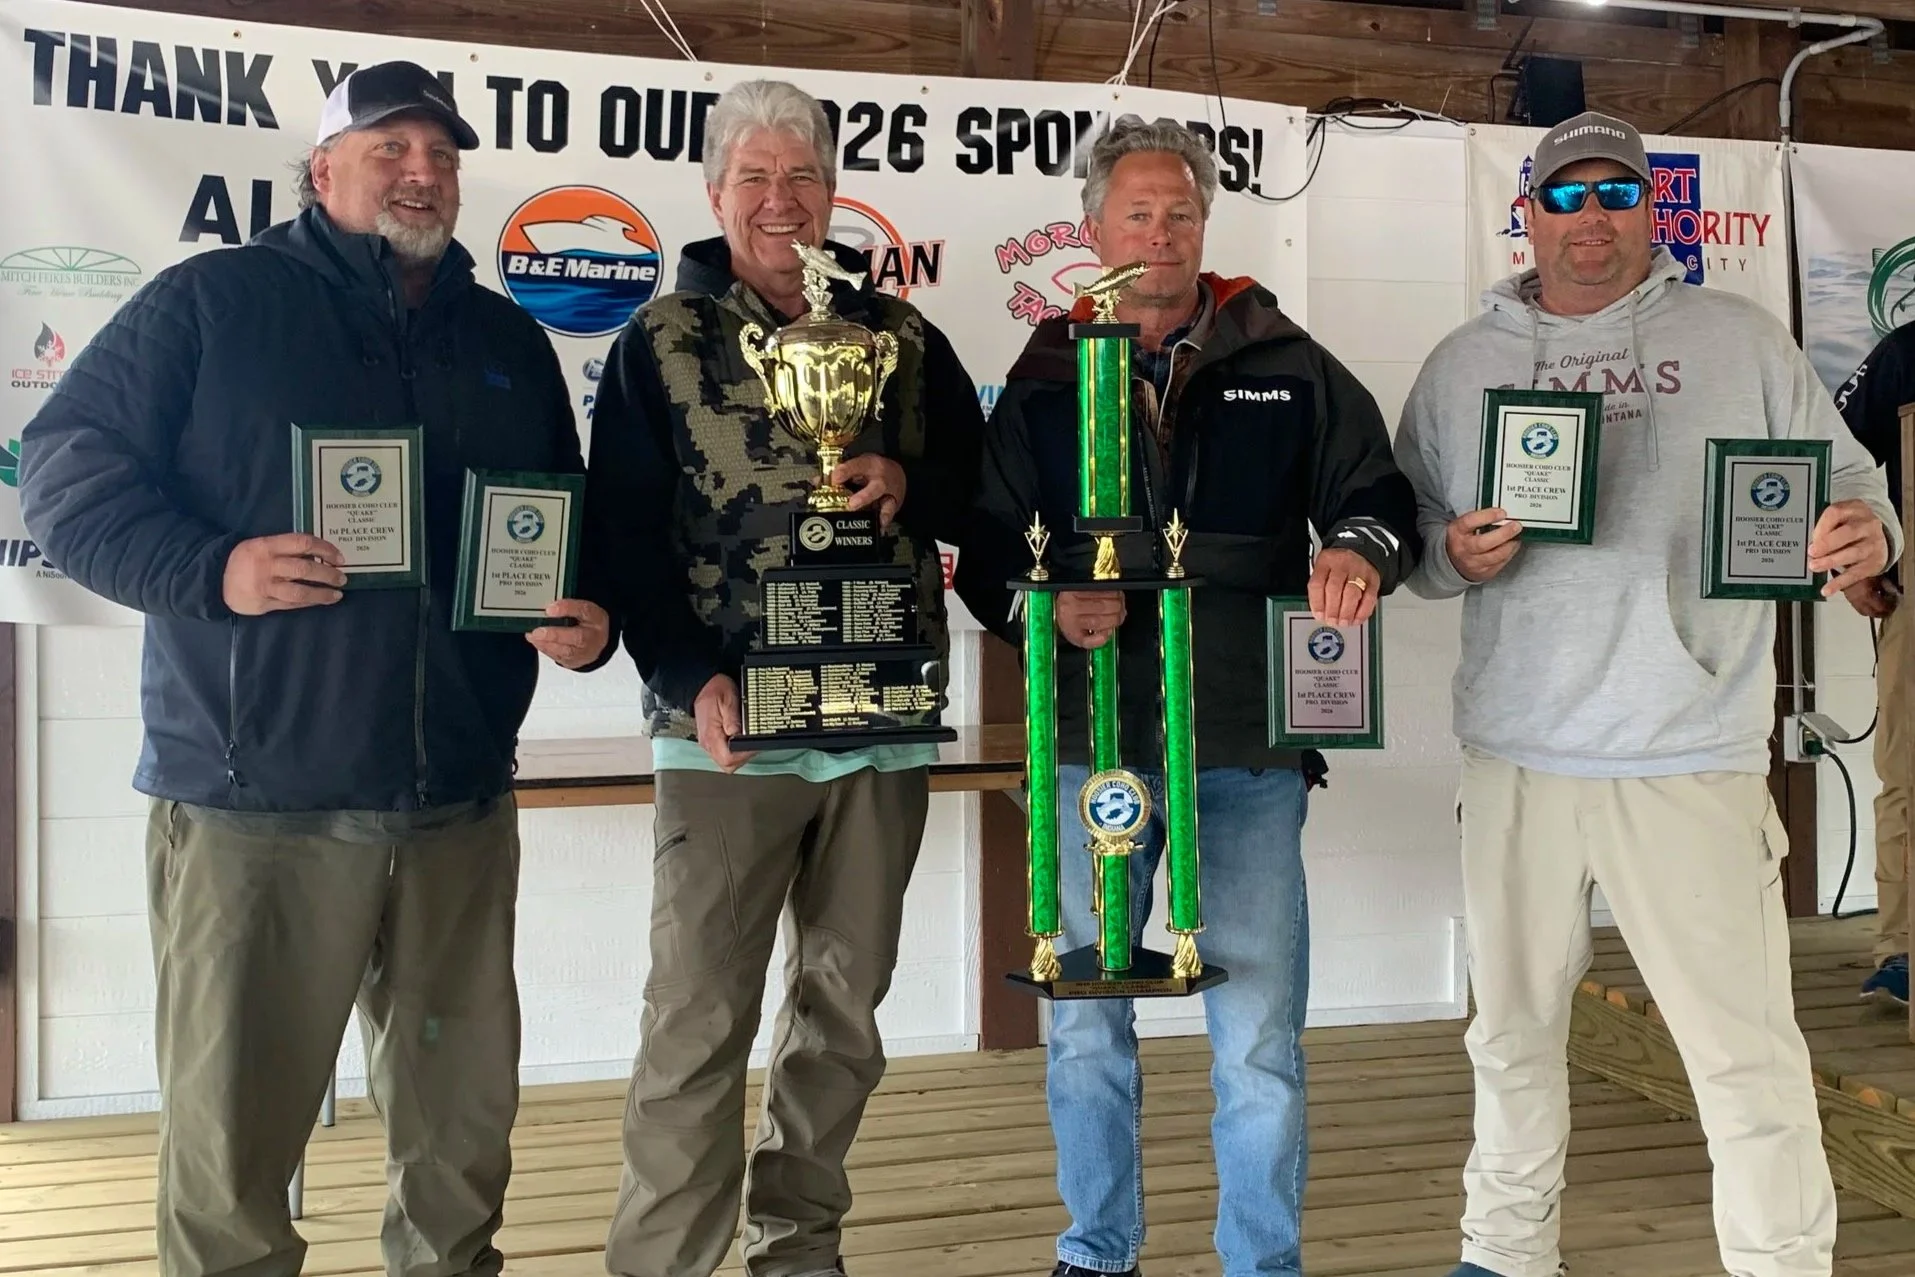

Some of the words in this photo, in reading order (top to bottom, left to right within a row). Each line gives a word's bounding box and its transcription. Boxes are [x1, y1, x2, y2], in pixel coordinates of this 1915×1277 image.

[24, 28, 280, 130] THANK
[486, 75, 570, 154] TO
[956, 107, 1263, 194] SPONS!
[1553, 125, 1626, 146] SHIMANO
[1652, 167, 1697, 204] RT
[1650, 208, 1772, 247] HORITY
[507, 255, 564, 277] B&E
[564, 258, 656, 281] Marine
[1686, 254, 1747, 272] CITY
[0, 271, 36, 282] MITCH
[73, 273, 122, 286] BUILDERS
[1534, 360, 1555, 372] The
[1560, 348, 1629, 370] Original
[1223, 389, 1292, 402] SIMMS
[836, 520, 870, 529] CLASSIC
[835, 536, 873, 546] WINNERS
[1112, 781, 1129, 790] COHO
